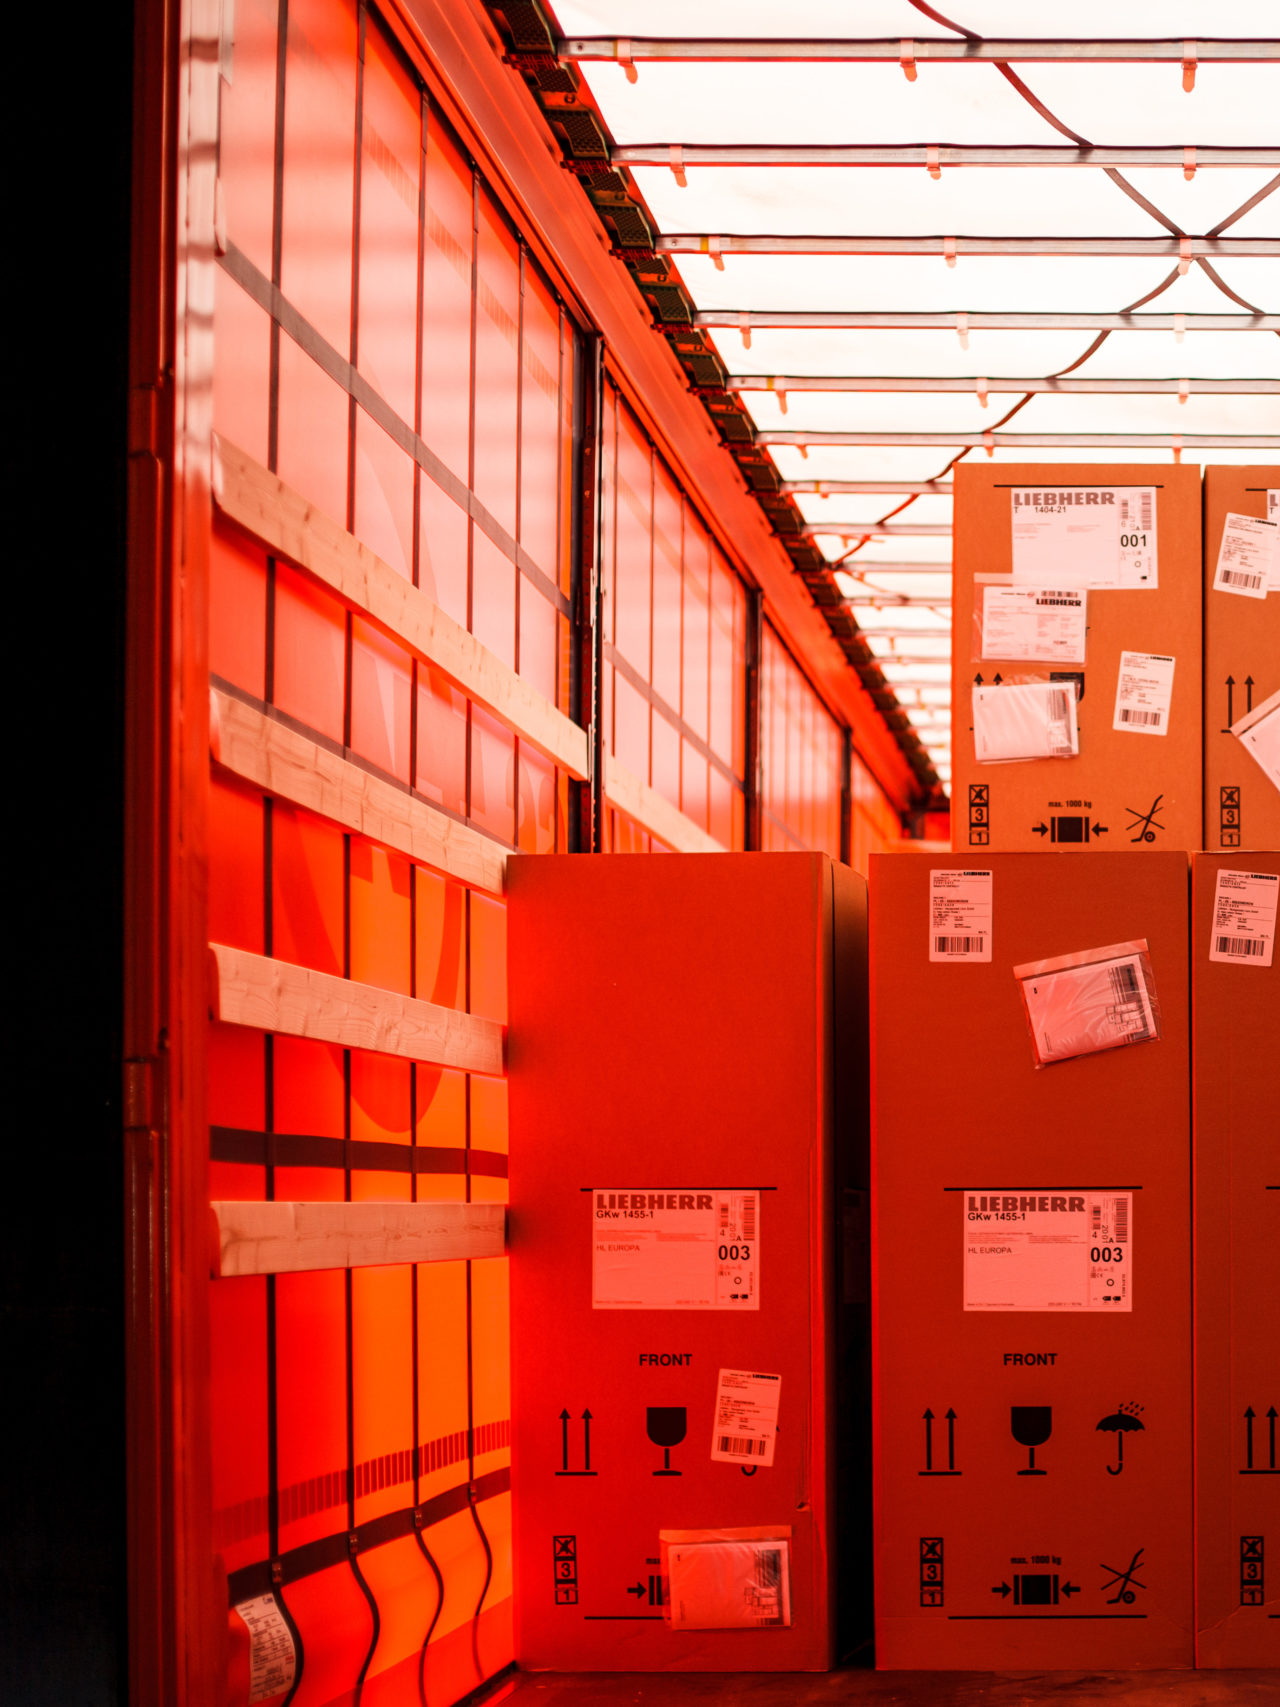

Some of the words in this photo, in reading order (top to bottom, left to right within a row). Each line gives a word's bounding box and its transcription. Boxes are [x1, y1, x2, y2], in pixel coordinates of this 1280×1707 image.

[1013, 492, 1115, 506] LIEBHERR
[1034, 505, 1067, 514] 1404-21
[1120, 534, 1148, 547] 001
[1036, 598, 1082, 607] LIEBHERR
[1083, 800, 1092, 809] kg
[975, 808, 983, 822] 3
[1226, 810, 1235, 824] 3
[596, 1193, 713, 1210] LIEBHERR
[968, 1196, 1086, 1212] LIEBHERR
[596, 1210, 620, 1219] GKw
[622, 1210, 655, 1219] 1455-1
[967, 1212, 991, 1221] GKw
[994, 1212, 1027, 1221] 1455-1
[718, 1245, 751, 1261] 003
[1090, 1247, 1123, 1263] 003
[639, 1353, 693, 1367] FRONT
[1003, 1352, 1058, 1367] FRONT
[1031, 1555, 1050, 1564] 1000
[1052, 1555, 1061, 1565] kg
[561, 1562, 571, 1578] 3
[927, 1565, 937, 1580] 3
[1247, 1563, 1258, 1579] 3
